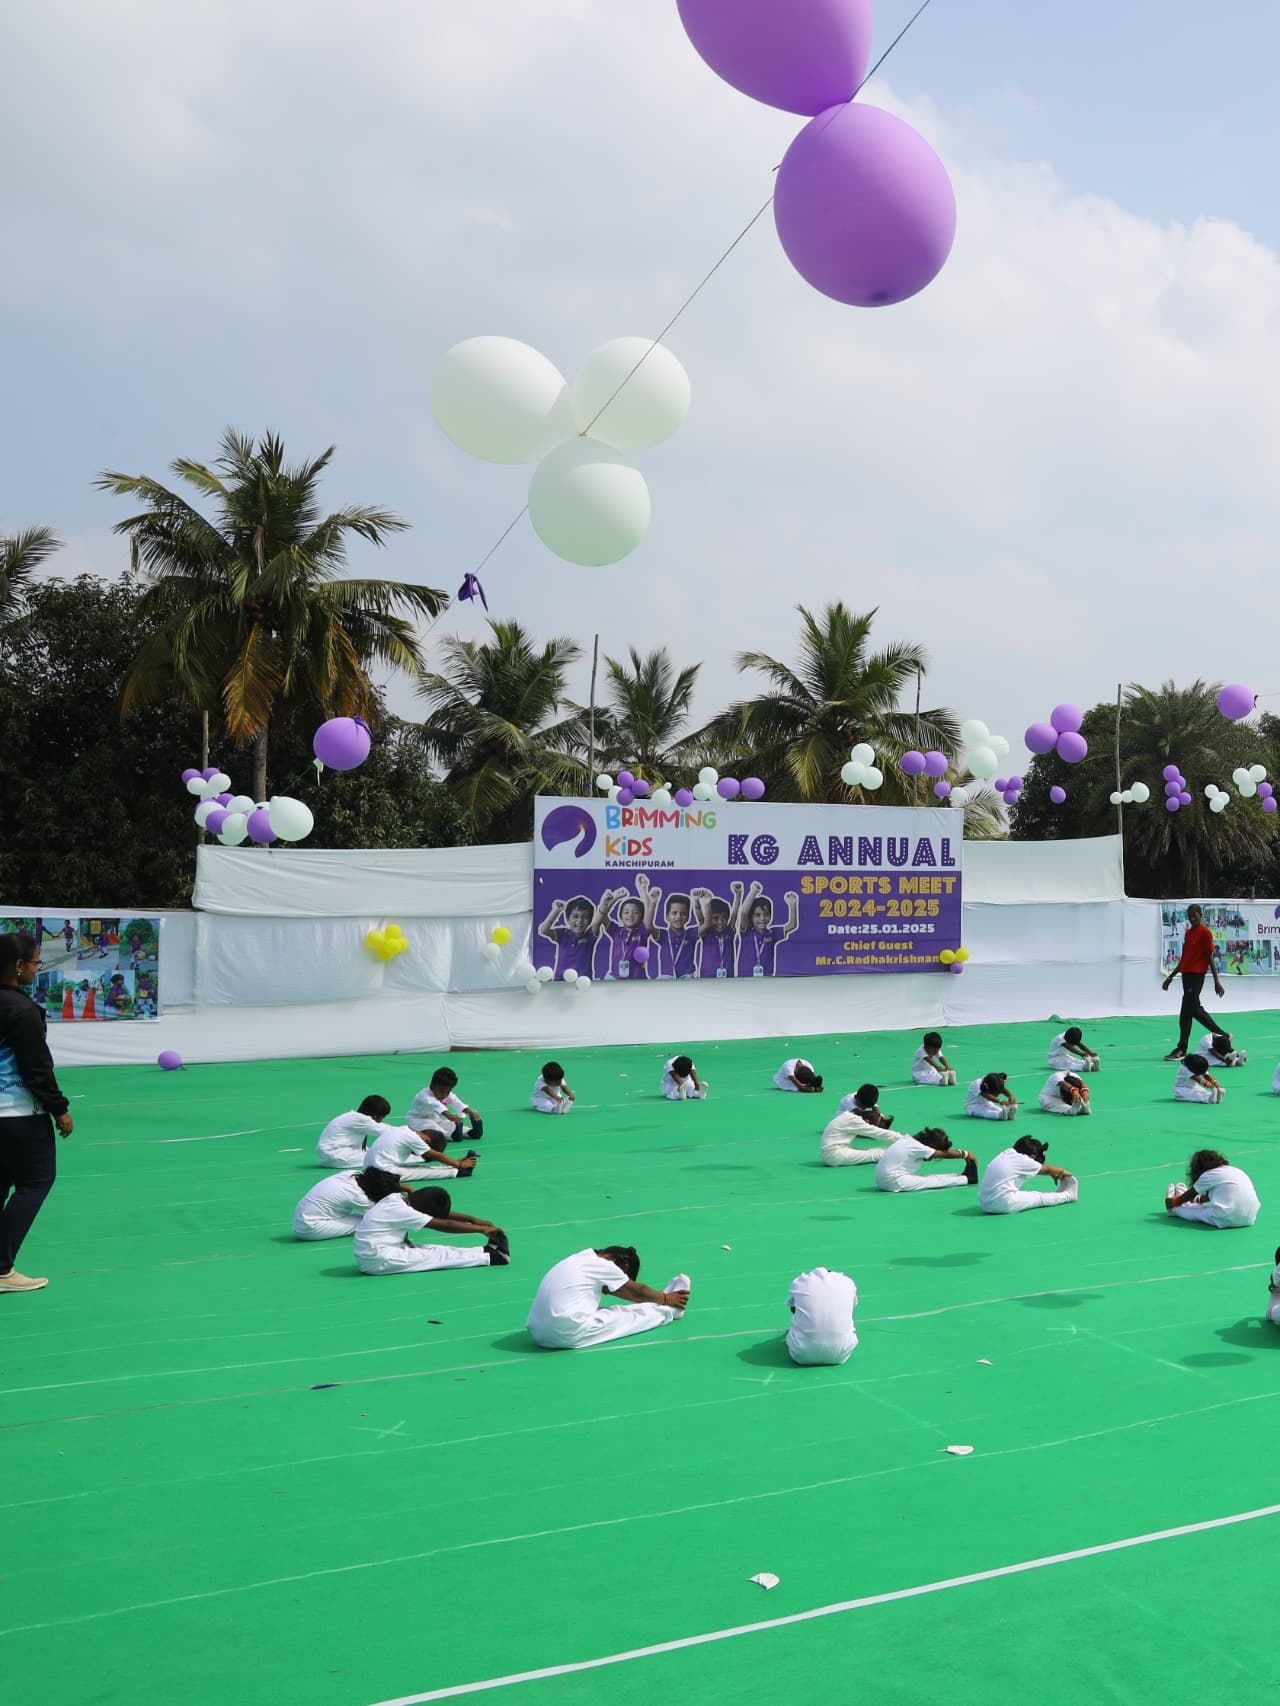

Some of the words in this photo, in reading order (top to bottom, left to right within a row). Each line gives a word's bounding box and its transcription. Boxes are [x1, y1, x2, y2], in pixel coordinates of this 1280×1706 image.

[728, 834, 779, 866] KG
[797, 835, 956, 867] ANNUAL
[801, 876, 892, 894] SPORTS
[899, 877, 956, 894] MEET
[819, 899, 940, 918] 2024-2025
[828, 924, 935, 934] Date:25.01.2025
[844, 941, 875, 950] Chief
[879, 941, 912, 949] Guest
[816, 954, 940, 965] Mr.C.Radhakrishnan
